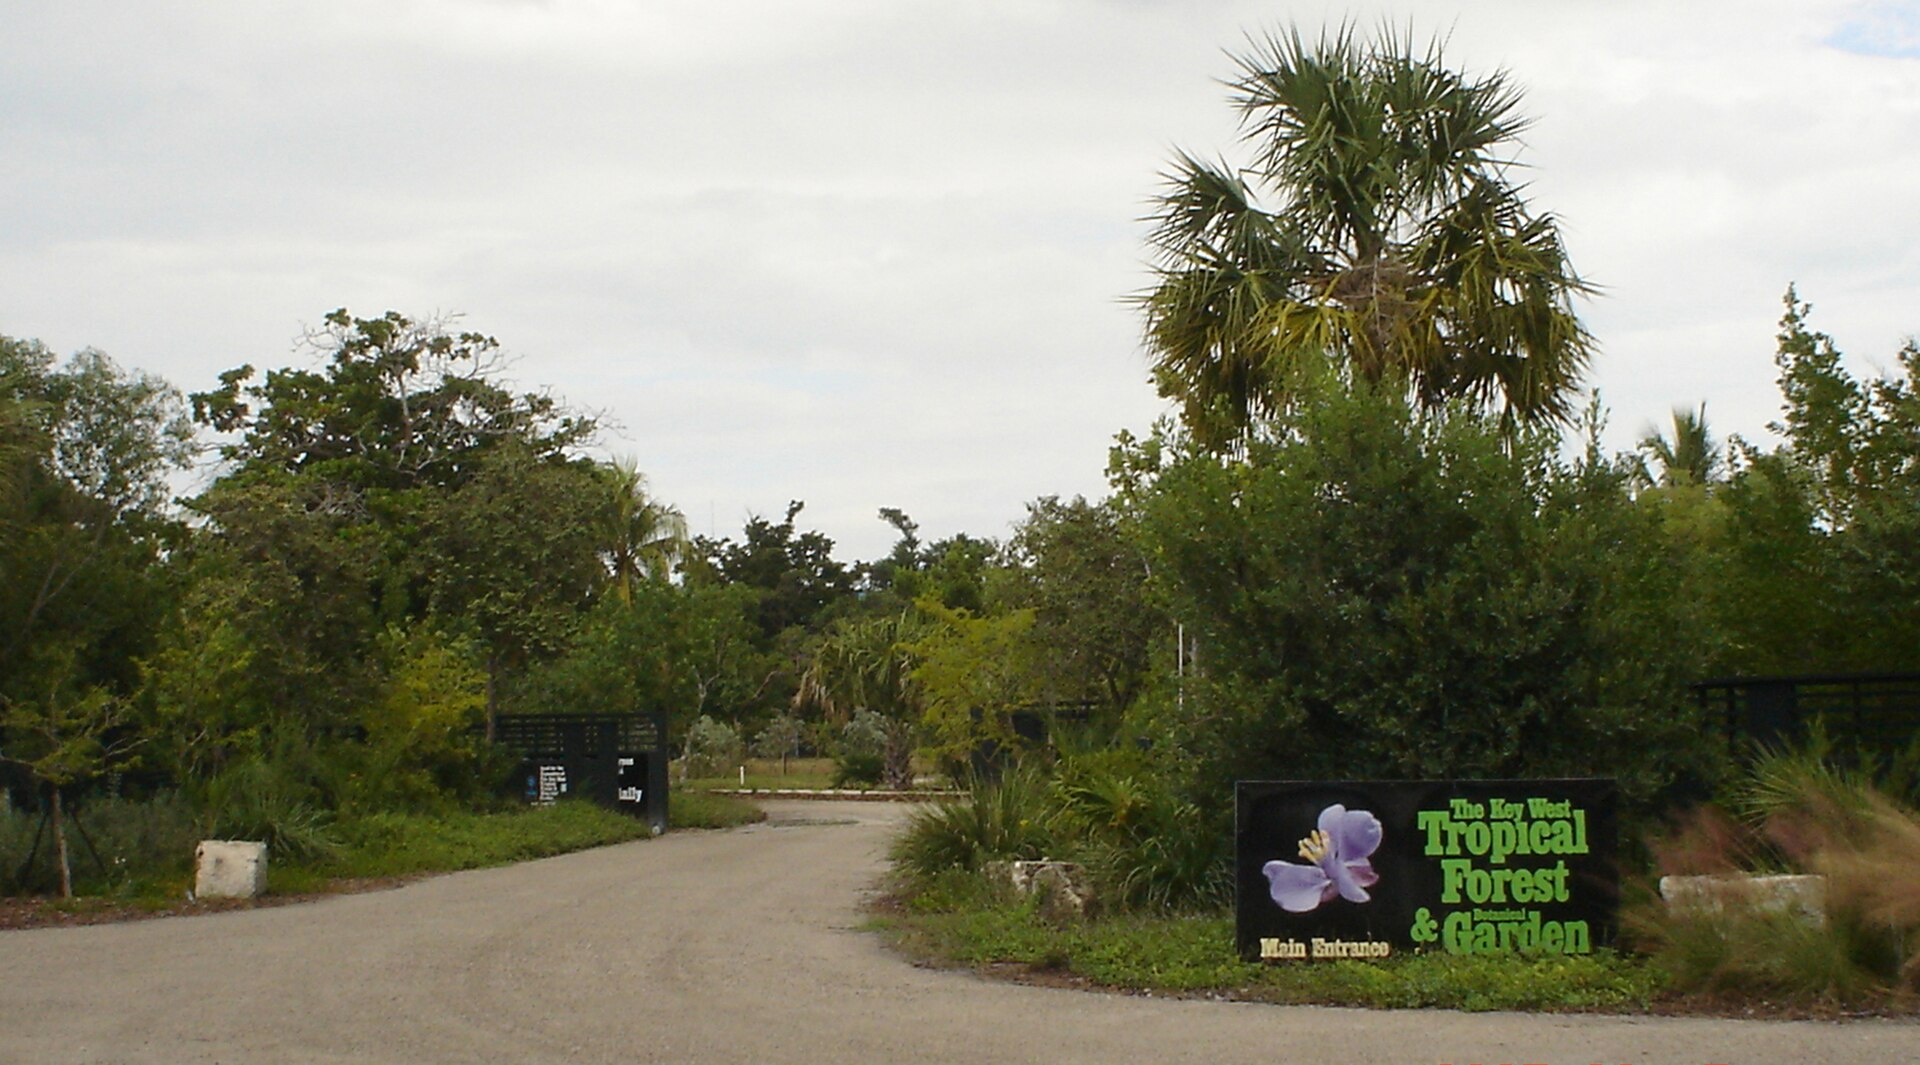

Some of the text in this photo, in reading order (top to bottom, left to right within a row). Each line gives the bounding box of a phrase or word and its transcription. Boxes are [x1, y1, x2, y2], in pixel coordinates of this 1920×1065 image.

[1450, 798, 1571, 821] The Key West
[1418, 809, 1589, 863] Tropical
[1440, 859, 1569, 904] Forest
[1410, 908, 1590, 955] & Garden
[1473, 908, 1526, 921] Botanical
[1260, 938, 1390, 958] Main Entrance
